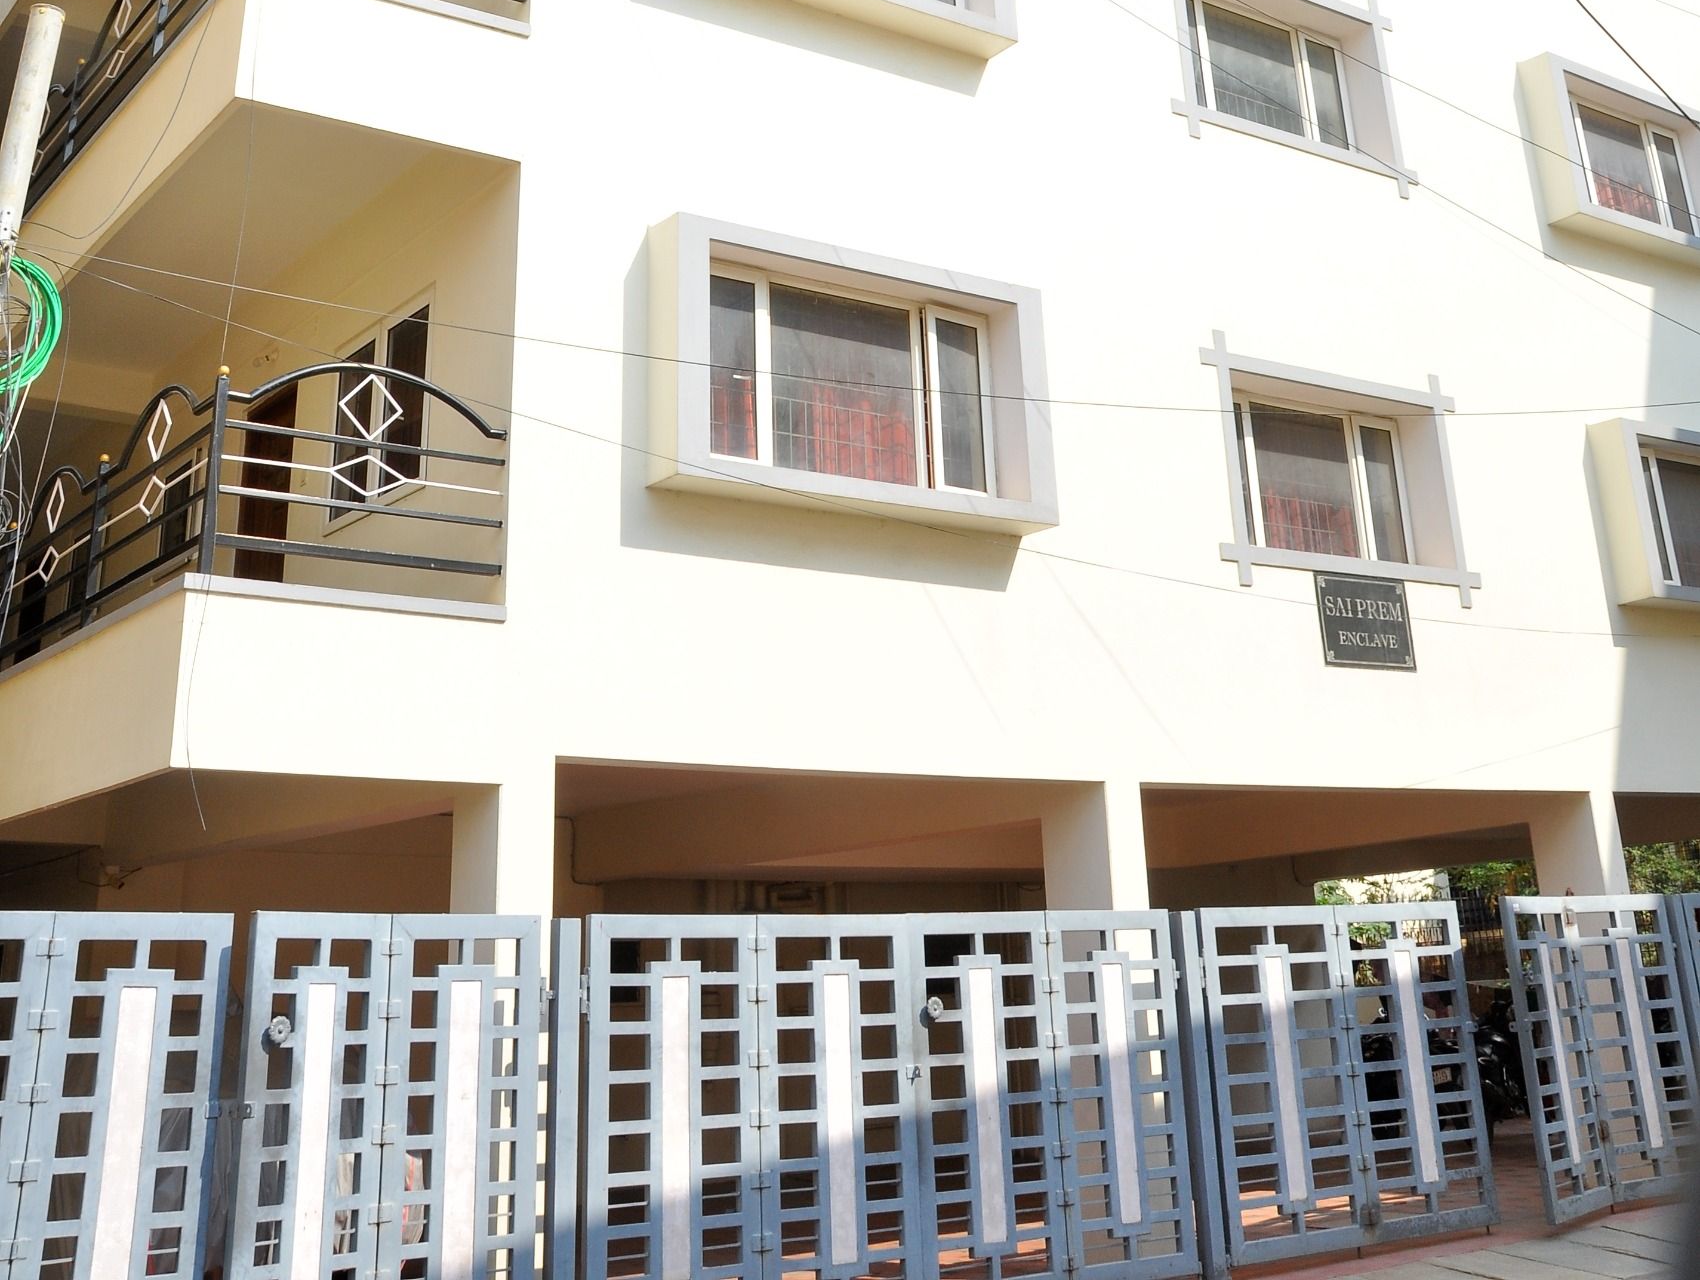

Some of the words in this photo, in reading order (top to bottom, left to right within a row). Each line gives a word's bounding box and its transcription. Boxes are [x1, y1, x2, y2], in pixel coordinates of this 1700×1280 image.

[1324, 595, 1353, 617] SAI
[1355, 599, 1403, 621] PREM
[1338, 630, 1398, 649] ENCLAVE
